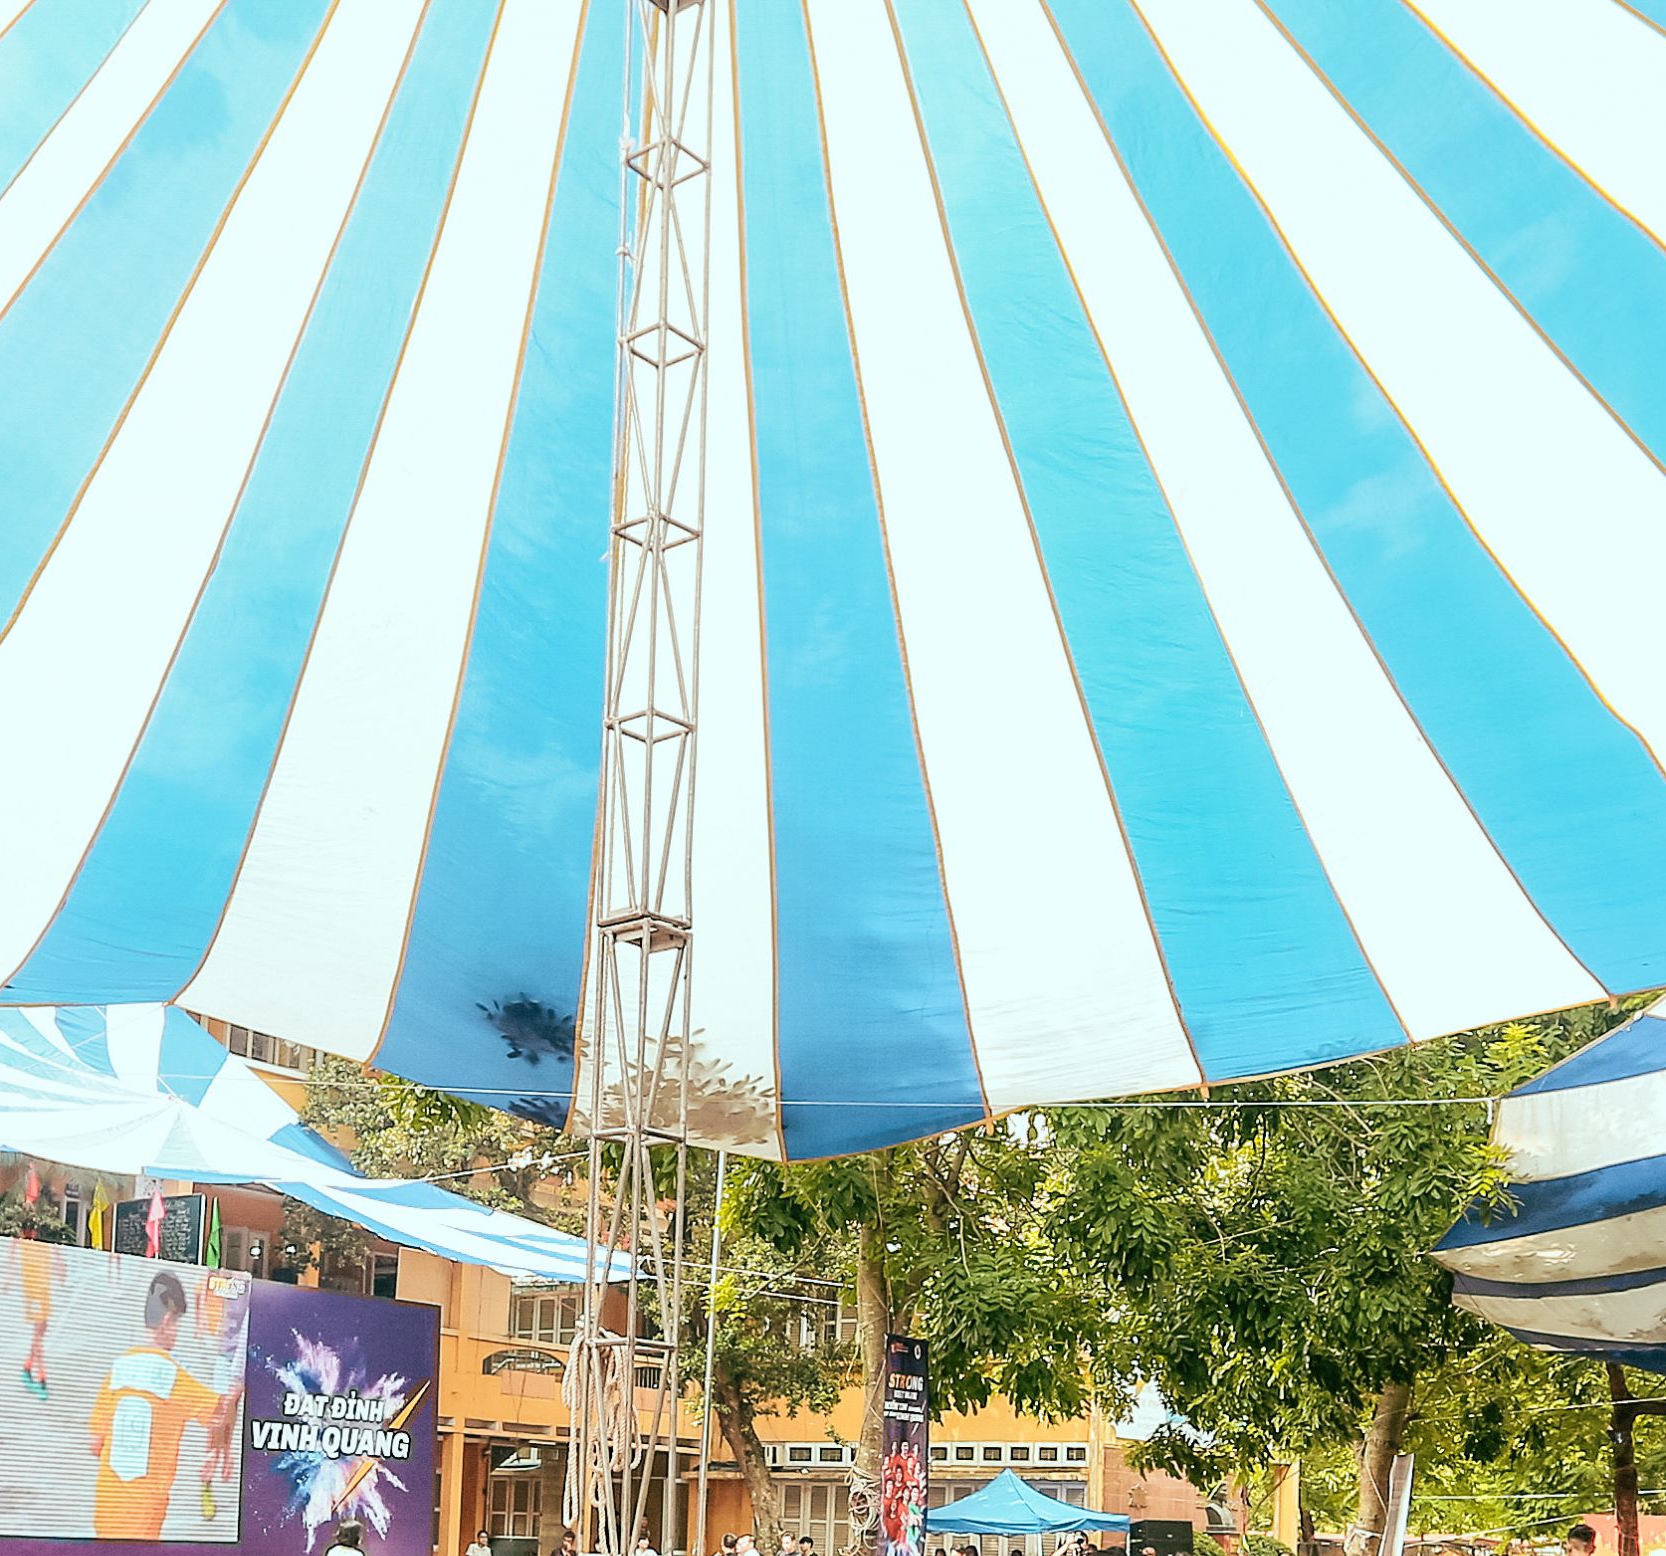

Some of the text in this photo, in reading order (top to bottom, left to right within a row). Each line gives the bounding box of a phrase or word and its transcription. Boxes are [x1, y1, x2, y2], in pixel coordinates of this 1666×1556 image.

[888, 1372, 924, 1392] STRONG
[284, 1389, 384, 1422] ĐẠT ĐỈNH
[251, 1420, 411, 1460] VINH QUANG
